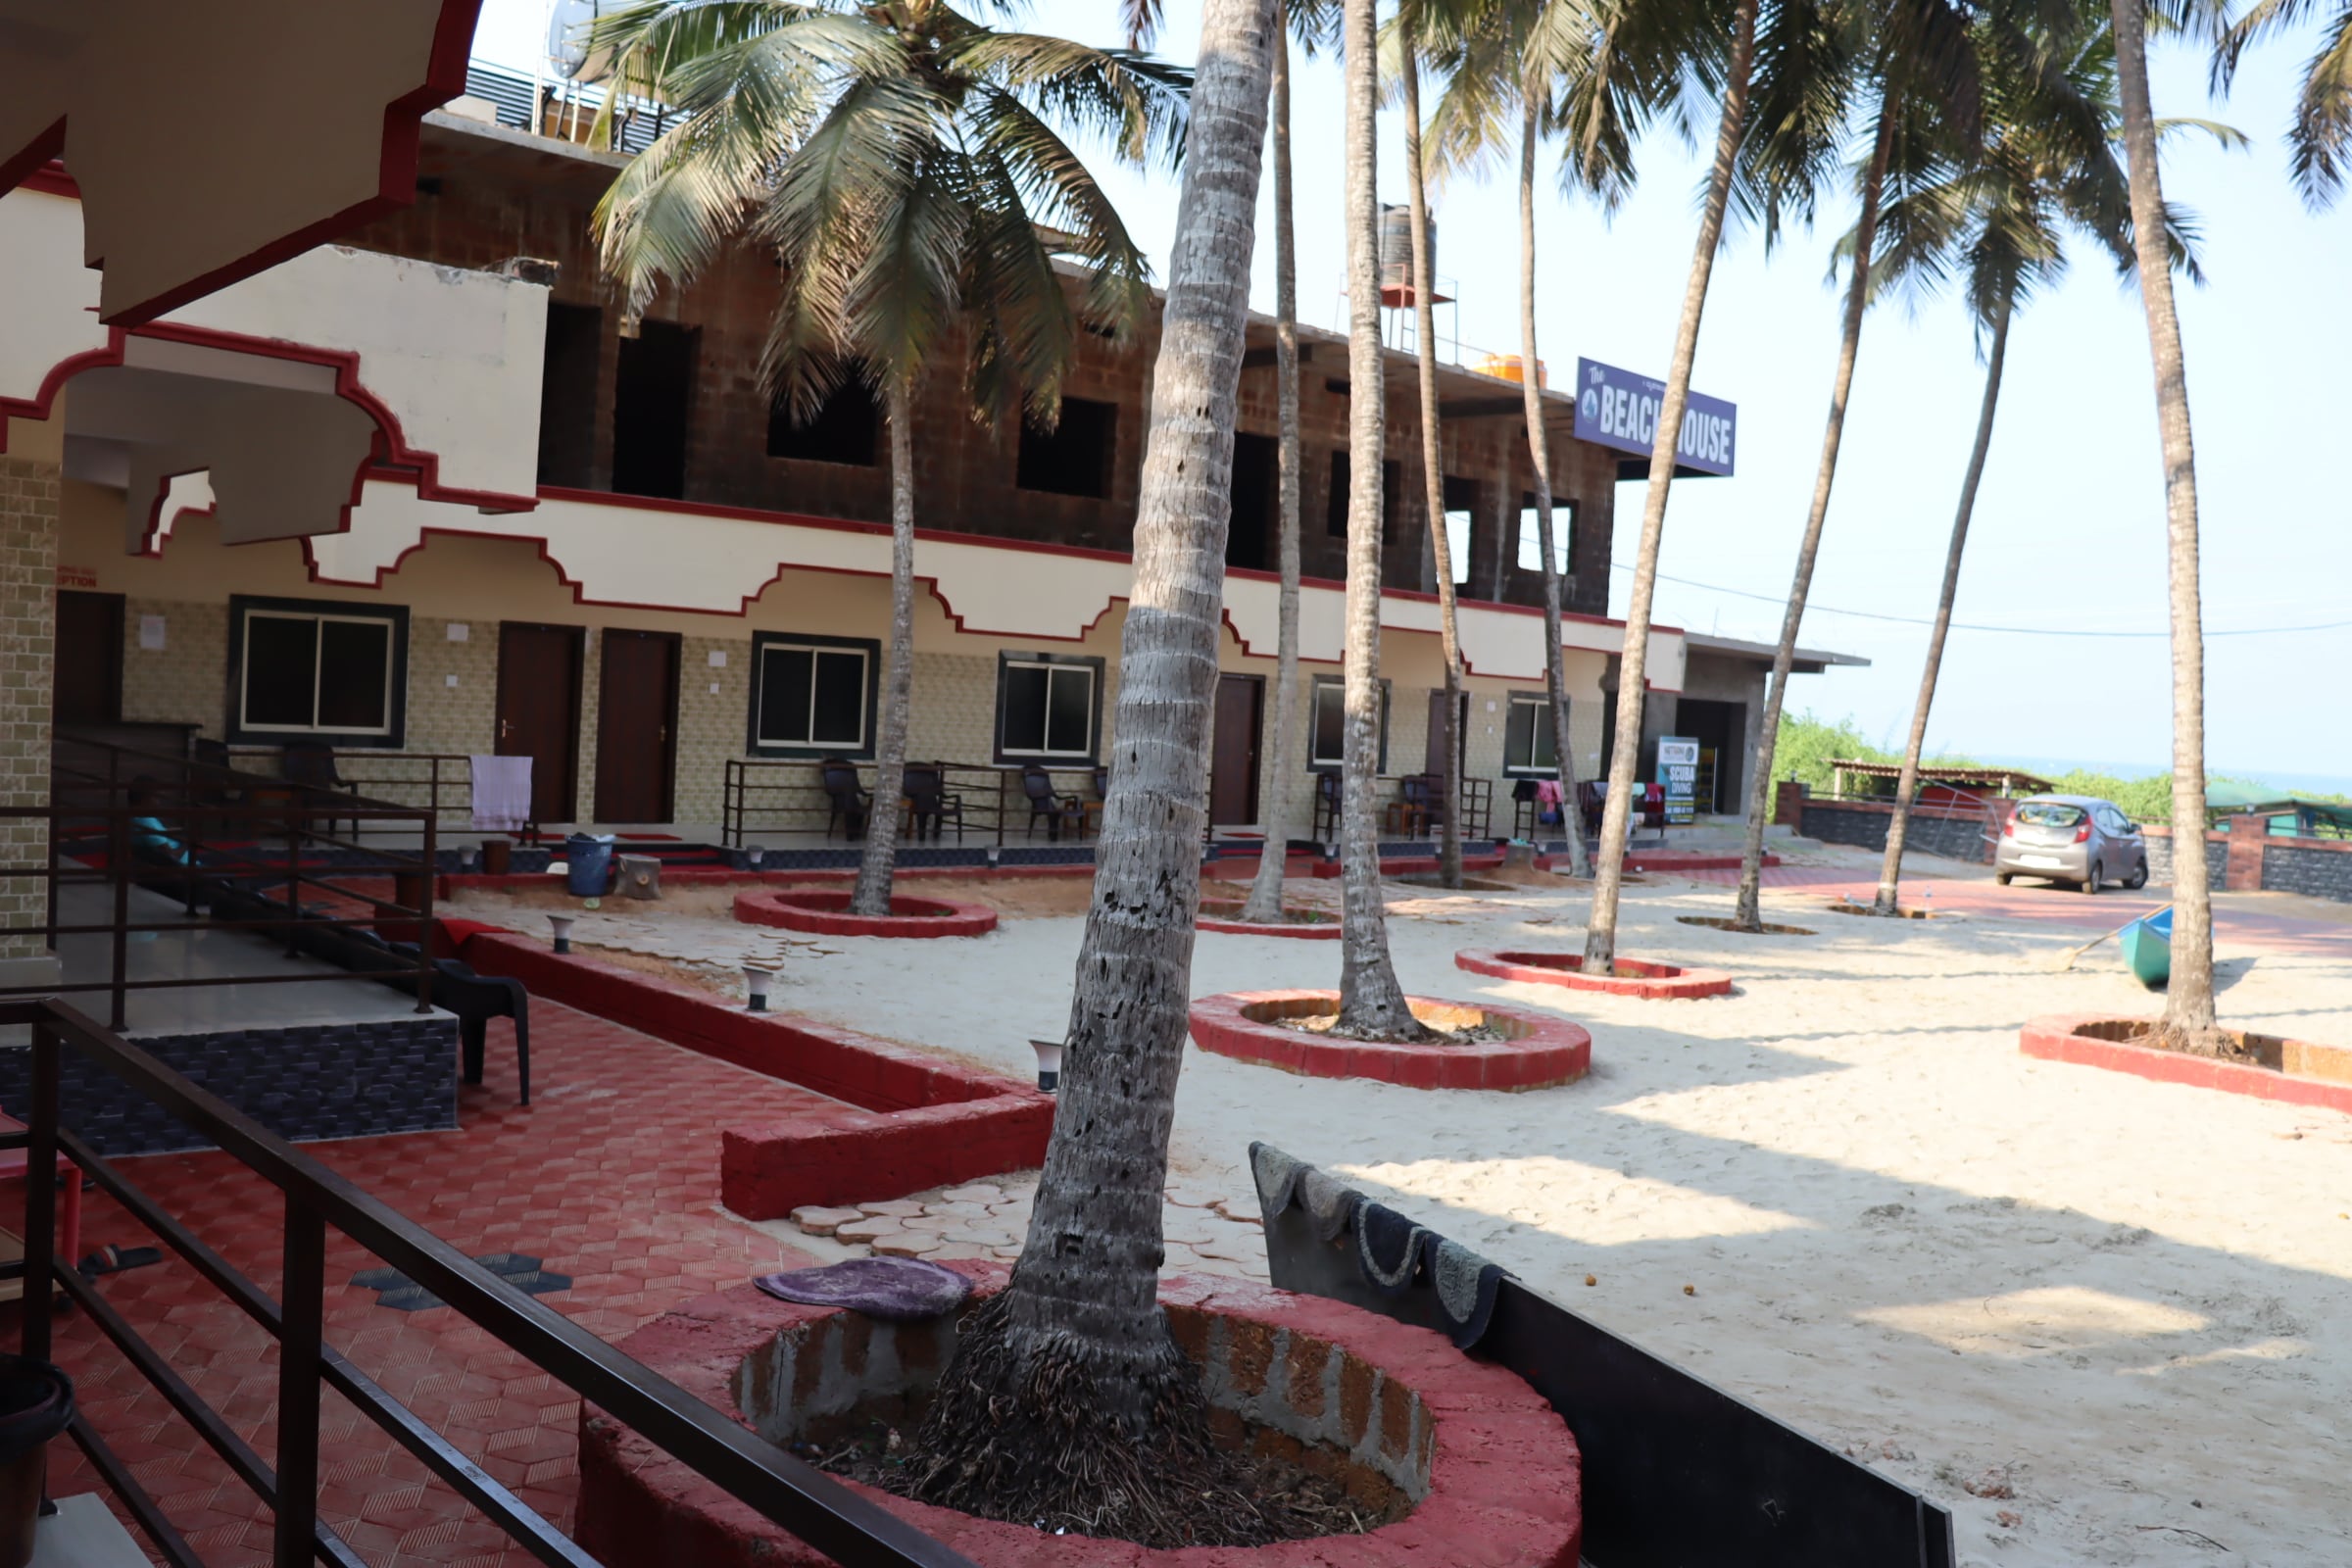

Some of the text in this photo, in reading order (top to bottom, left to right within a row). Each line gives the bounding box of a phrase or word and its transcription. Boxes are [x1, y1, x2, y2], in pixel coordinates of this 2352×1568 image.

[1589, 366, 1605, 384] The
[1678, 410, 1732, 465] OUSE
[1670, 765, 1694, 781] SCUBA
[1672, 782, 1691, 794] DIVING
